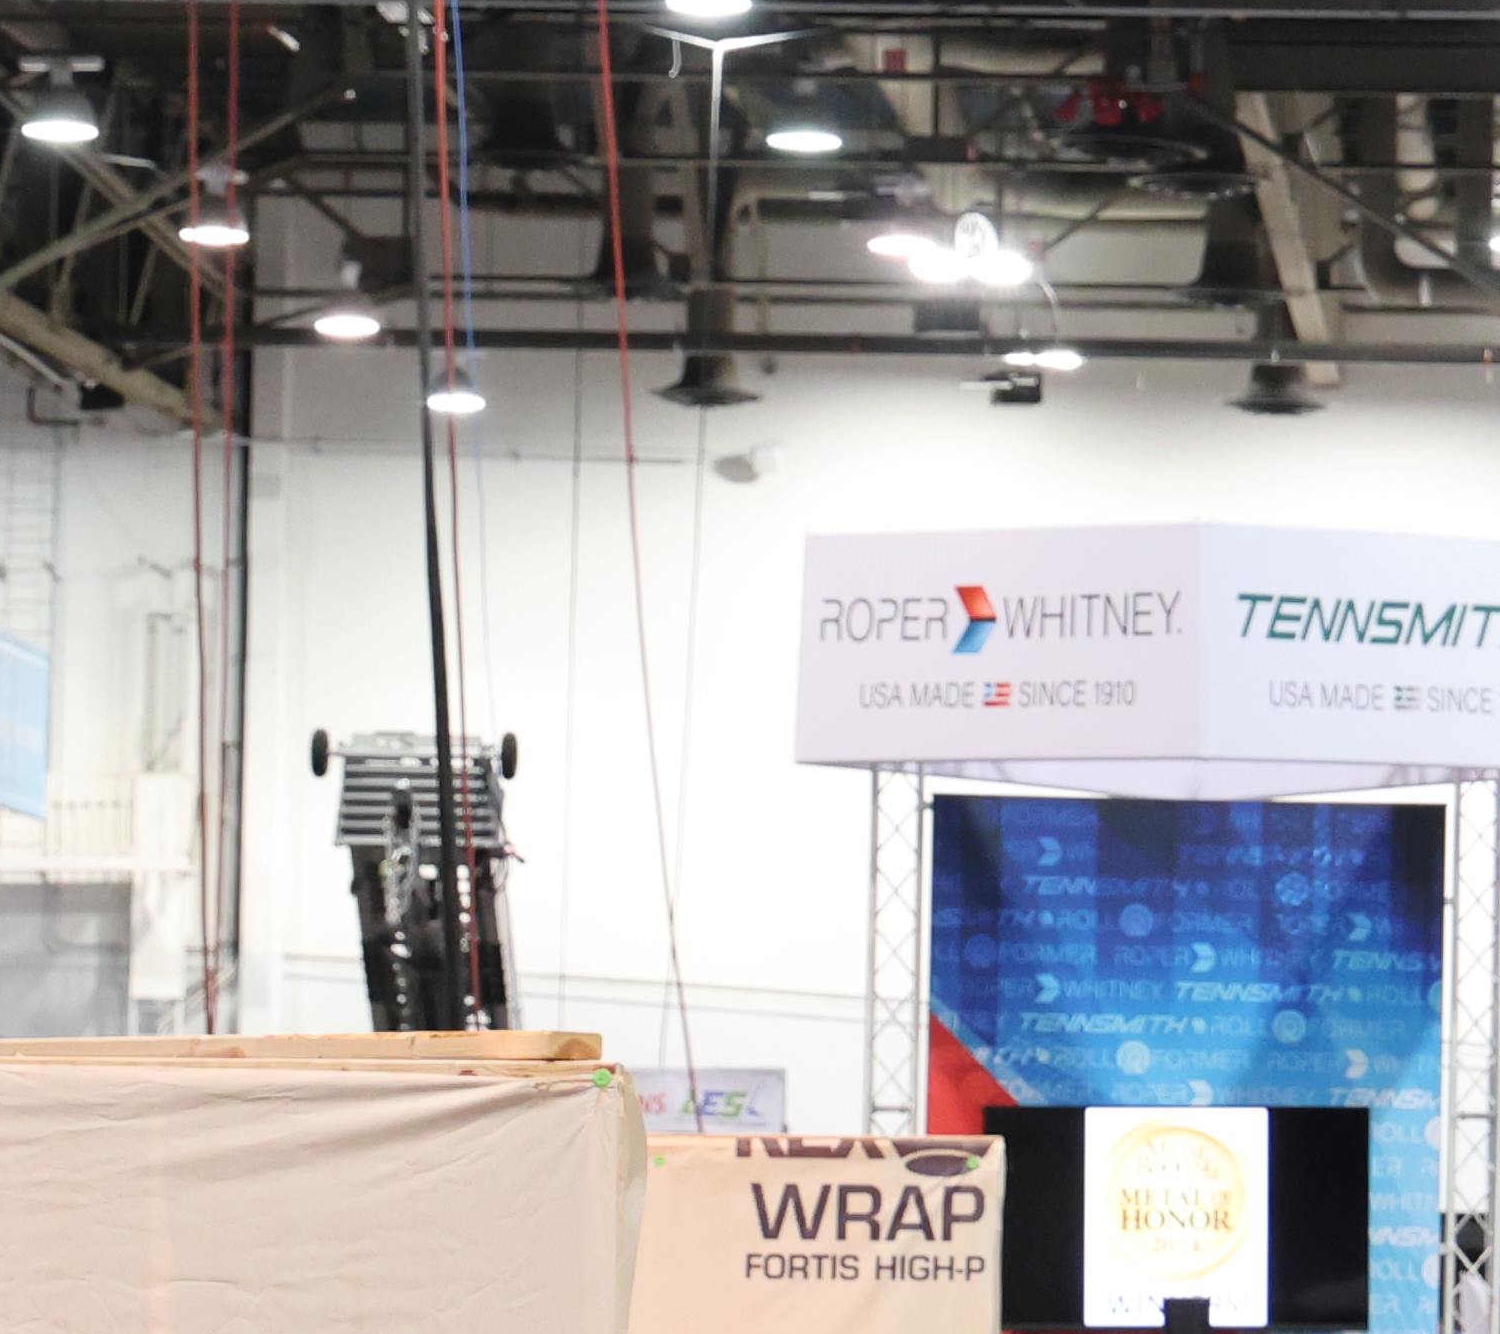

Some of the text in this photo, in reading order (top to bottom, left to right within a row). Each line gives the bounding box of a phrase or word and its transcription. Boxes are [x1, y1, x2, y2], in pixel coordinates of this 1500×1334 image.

[819, 598, 949, 643] ROPER
[859, 681, 1136, 709] USA MADE SINCE 1910
[1268, 681, 1313, 710] USA
[1320, 683, 1384, 712] MADE
[1426, 686, 1493, 715] SINCE
[1019, 1012, 1189, 1034] TENNSMITH
[751, 1182, 986, 1242] WRAP
[1121, 1209, 1235, 1232] HONOR
[746, 1254, 985, 1282] FORTIS HIGH-P
